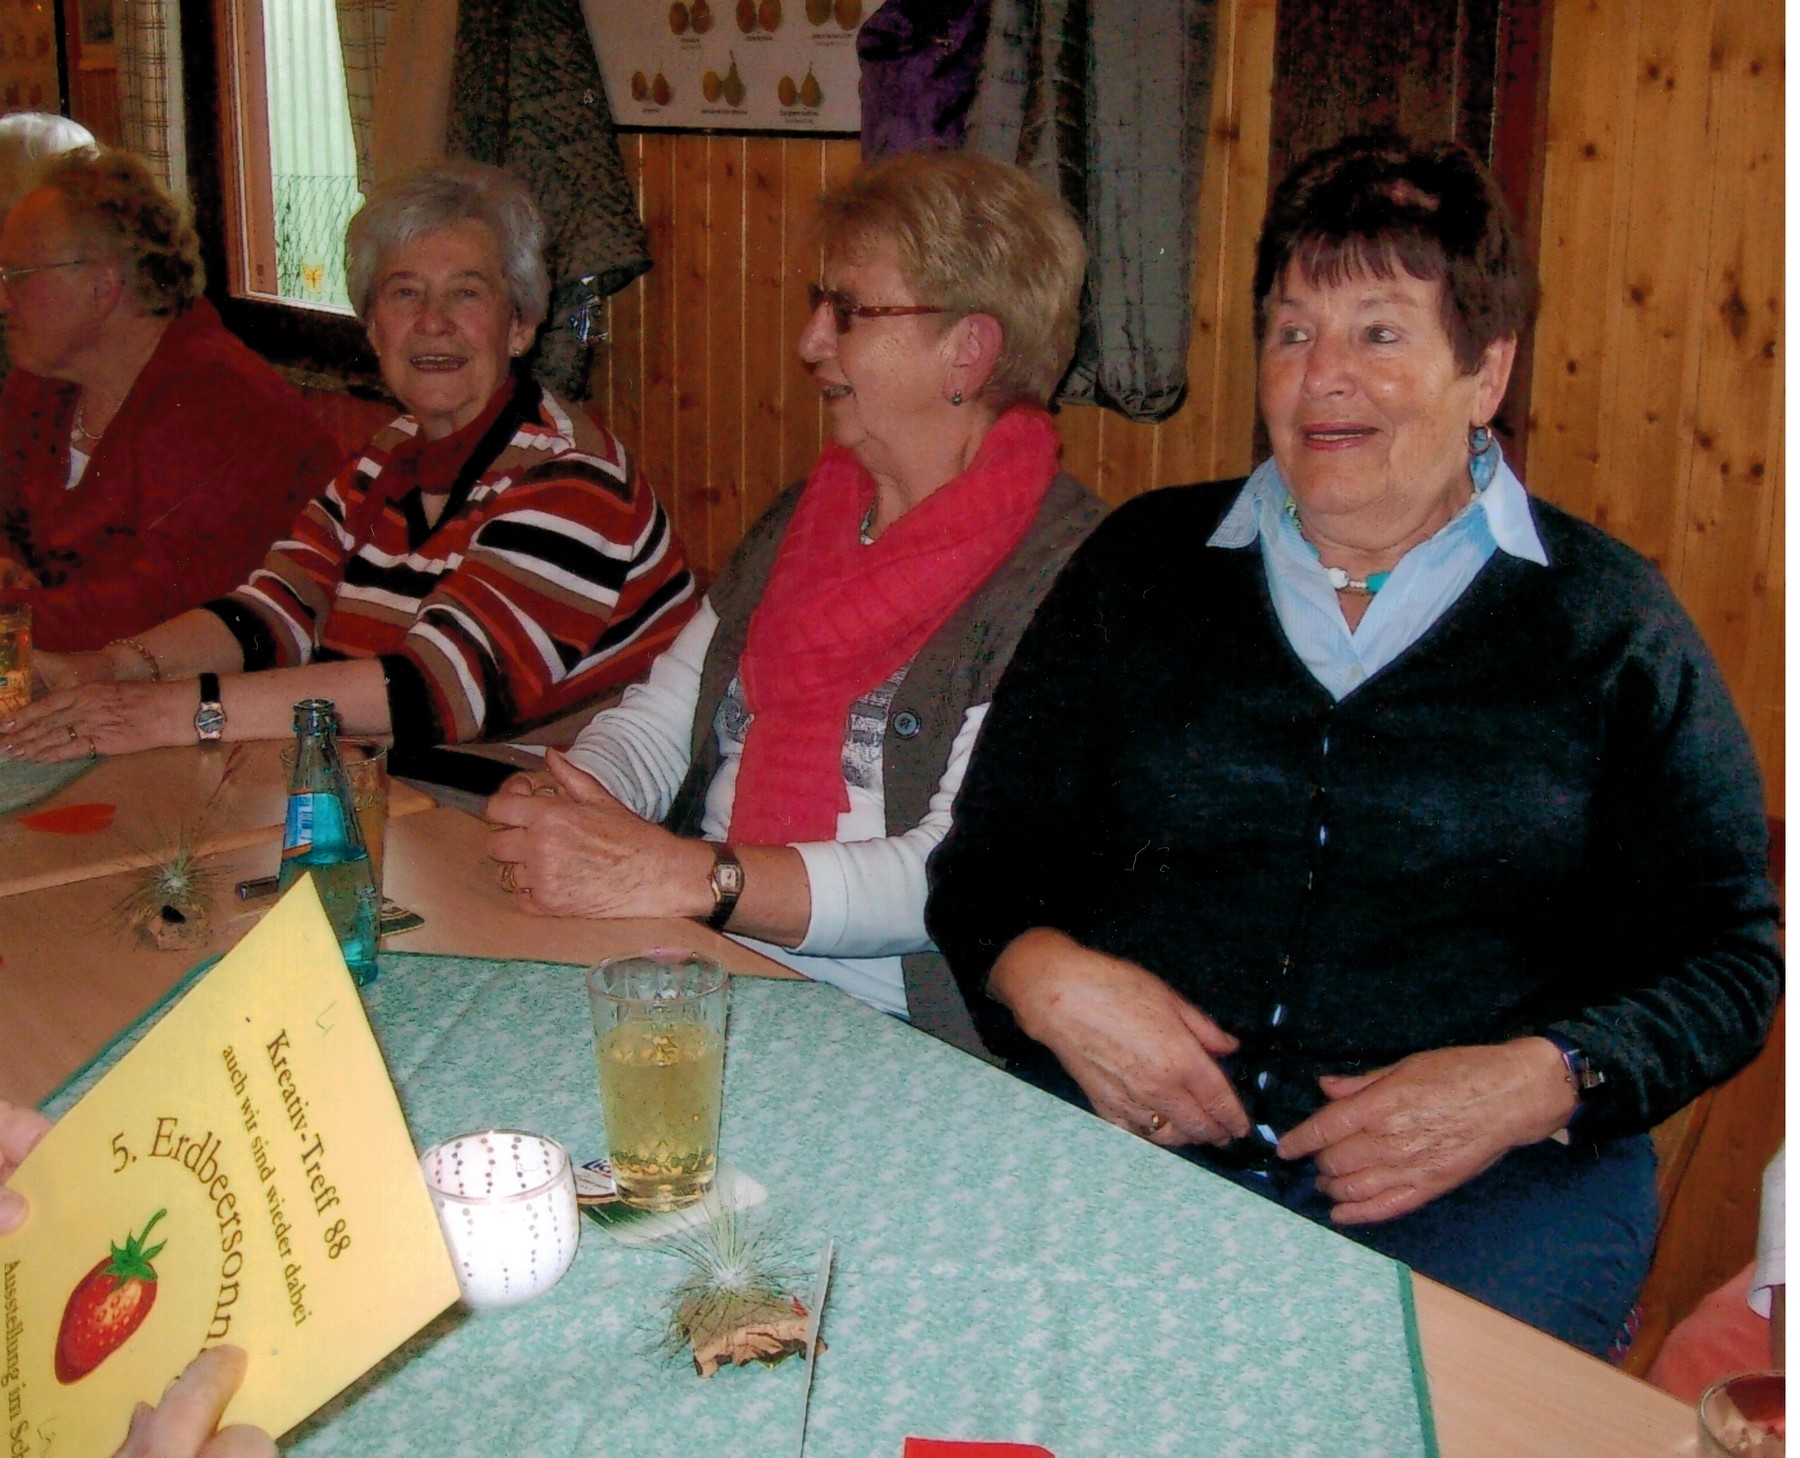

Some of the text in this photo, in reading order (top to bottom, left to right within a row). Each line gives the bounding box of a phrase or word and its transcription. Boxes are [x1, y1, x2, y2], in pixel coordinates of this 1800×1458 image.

[111, 1116, 244, 1353] 5. Erdbeersonn
[222, 1044, 313, 1328] auch wir sind wieder dabei
[266, 1028, 351, 1260] Kreativ-Treff 88
[2, 1259, 24, 1388] Ausstellung
[8, 1382, 27, 1422] im
